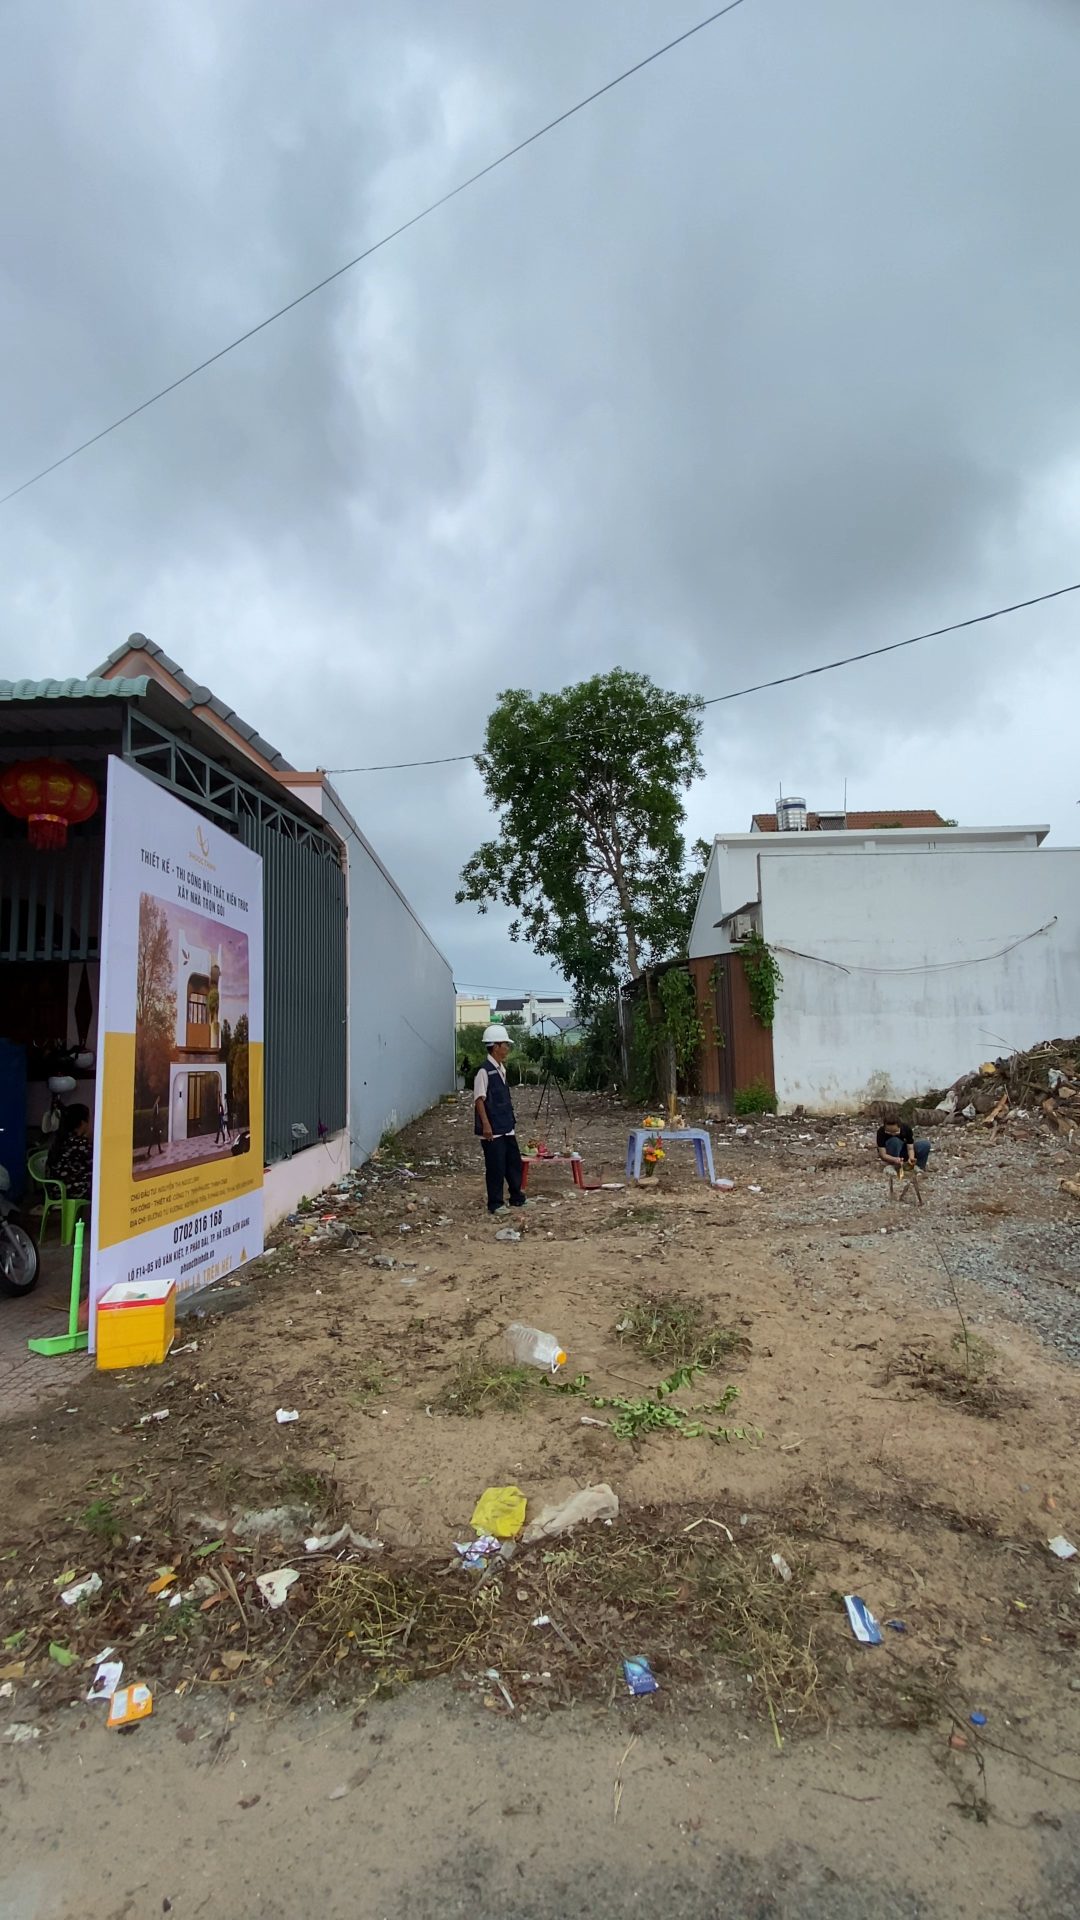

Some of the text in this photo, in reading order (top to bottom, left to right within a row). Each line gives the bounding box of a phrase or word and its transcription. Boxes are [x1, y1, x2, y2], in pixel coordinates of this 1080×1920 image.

[141, 848, 160, 869] THIẾT
[161, 858, 170, 874] KẾ
[176, 866, 186, 882] THI
[187, 871, 201, 889] CÔNG
[203, 880, 212, 895] NỘI
[177, 885, 189, 901] XÂY
[174, 1210, 223, 1244] 0702 816 168
[128, 1269, 135, 1282] LÔ
[136, 1261, 154, 1278] F14-05
